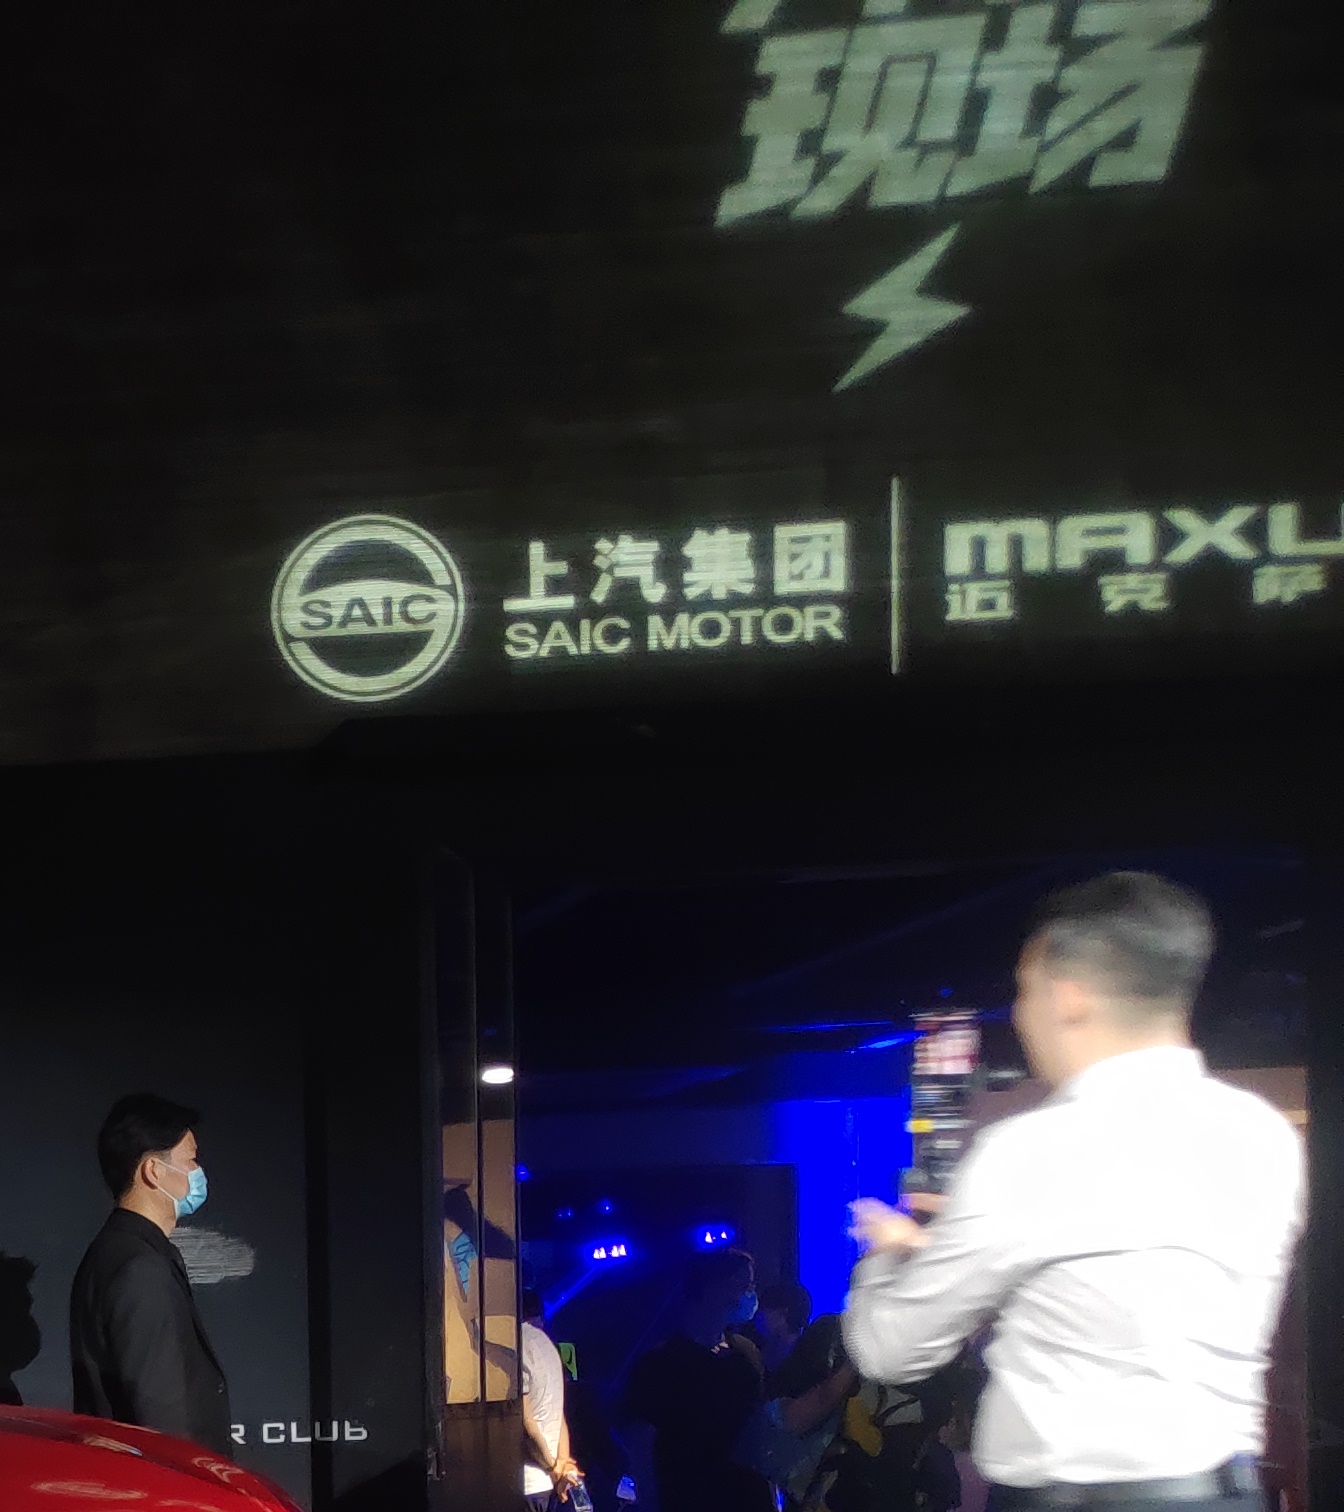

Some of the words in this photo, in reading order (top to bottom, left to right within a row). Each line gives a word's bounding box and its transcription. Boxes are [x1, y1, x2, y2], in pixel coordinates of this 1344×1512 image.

[503, 520, 848, 611] 上汽集团
[299, 592, 439, 631] SAIC
[503, 615, 634, 659] SAIC
[648, 607, 848, 651] MOTOR
